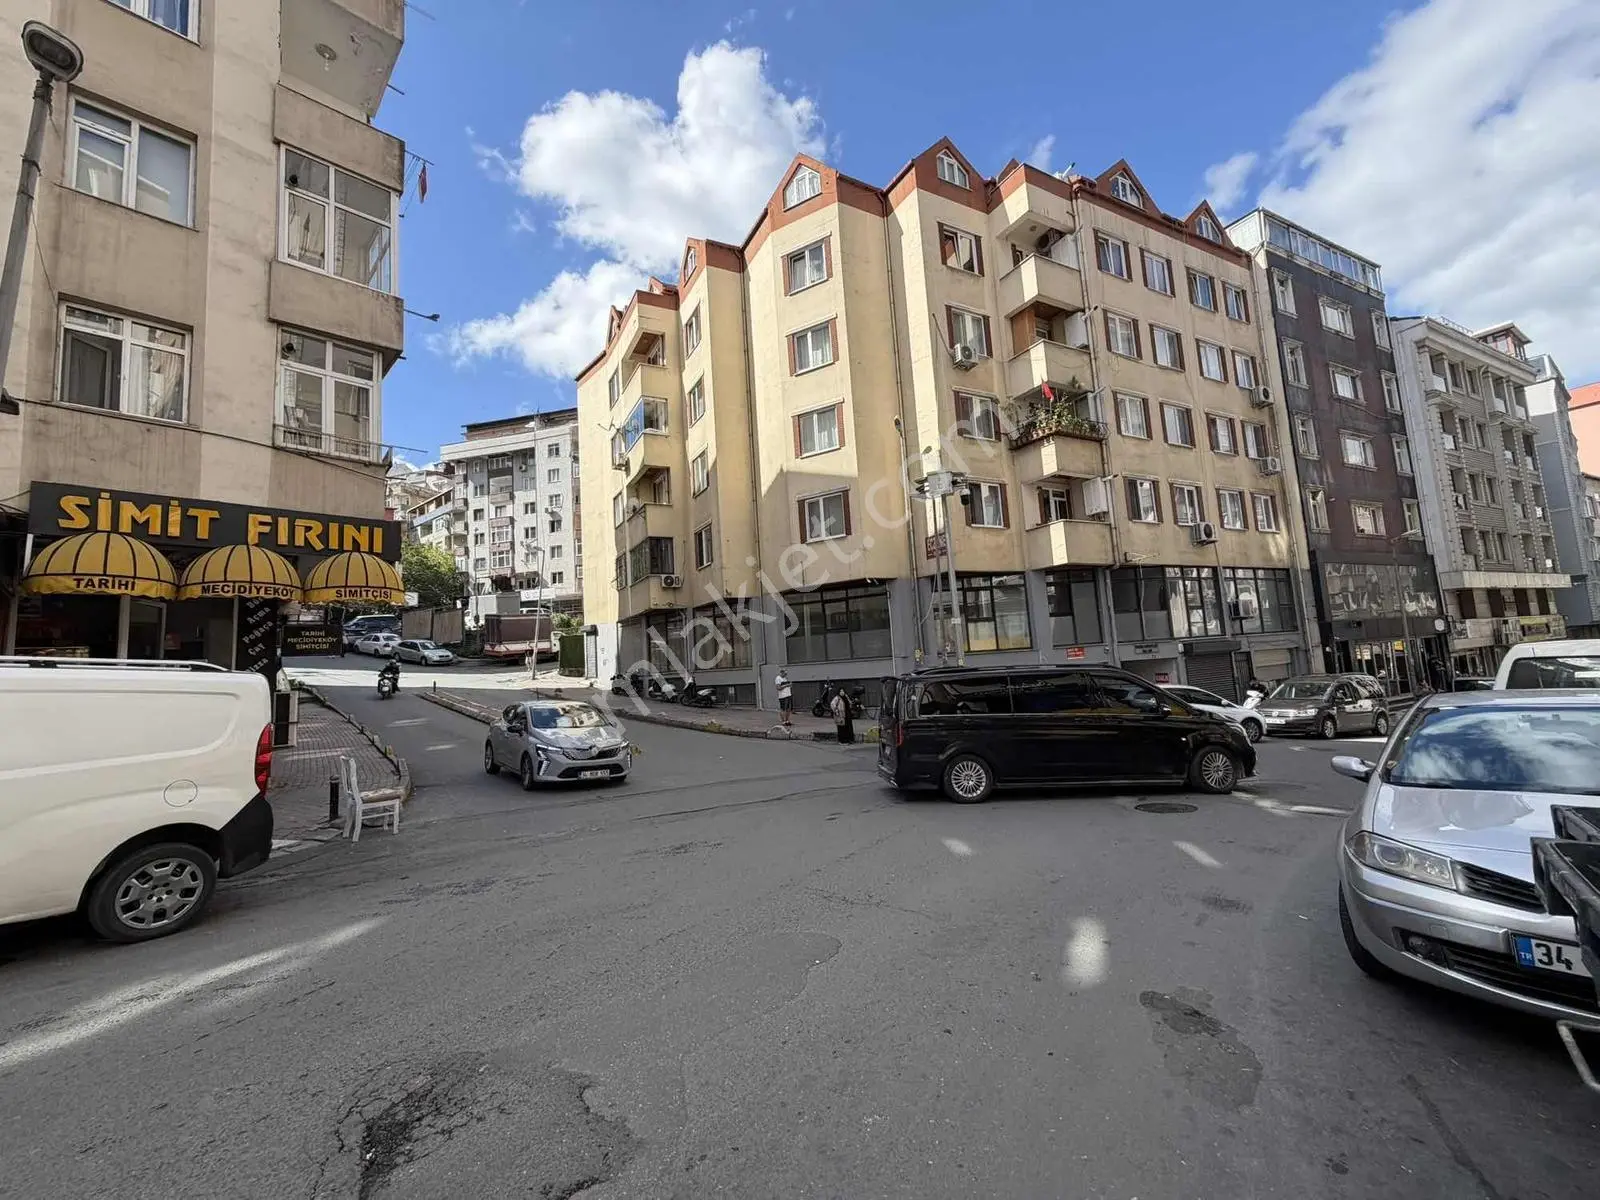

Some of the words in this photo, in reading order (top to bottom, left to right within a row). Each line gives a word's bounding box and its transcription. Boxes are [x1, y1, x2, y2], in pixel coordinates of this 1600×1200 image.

[57, 491, 221, 540] SİMİT
[248, 513, 383, 554] FIRINI
[1519, 952, 1533, 960] TR
[1534, 942, 1573, 970] 34
